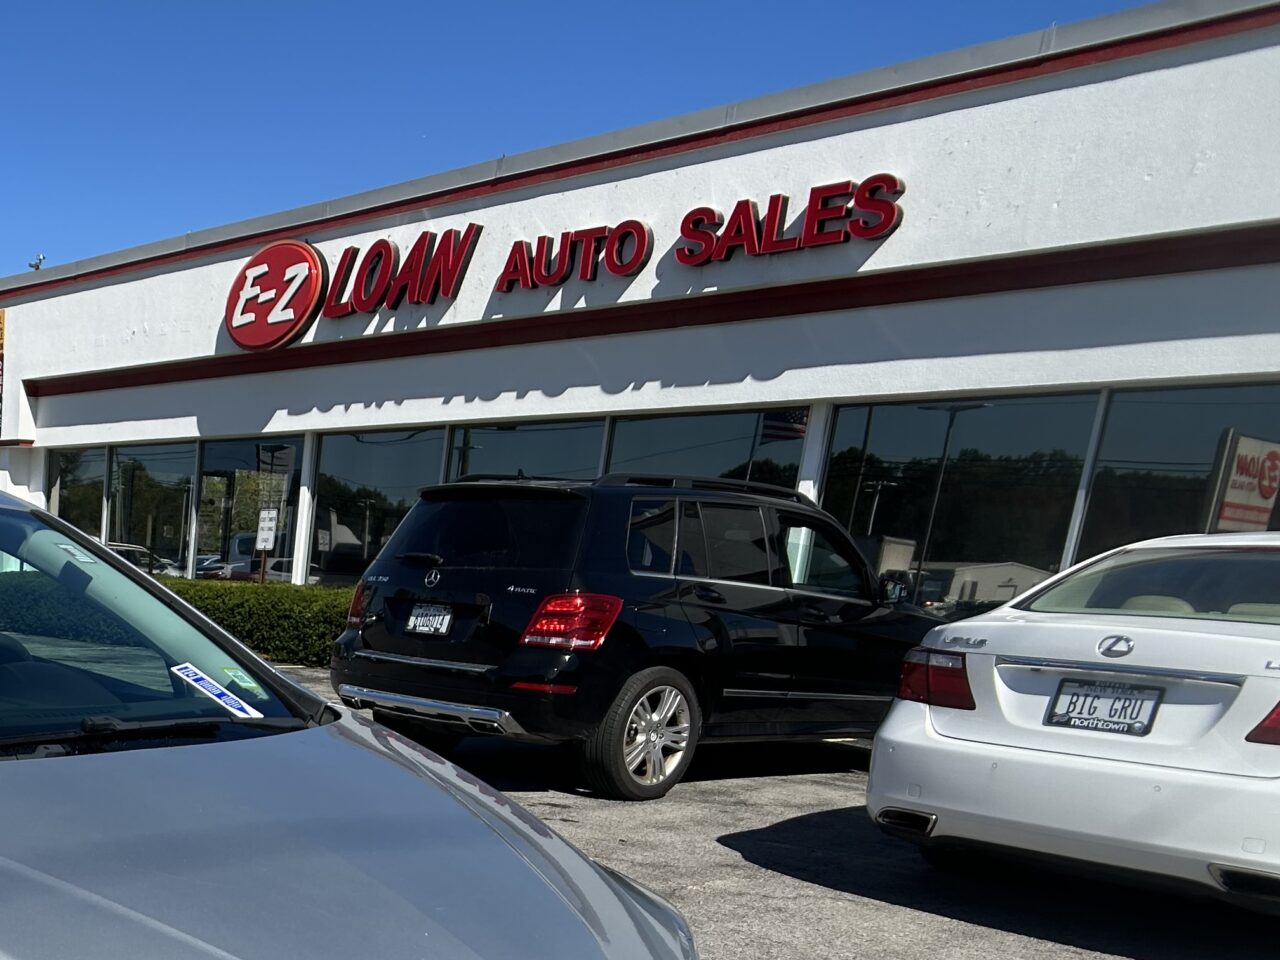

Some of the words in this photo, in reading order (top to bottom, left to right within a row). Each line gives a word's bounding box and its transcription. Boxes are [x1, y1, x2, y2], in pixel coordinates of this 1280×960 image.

[231, 262, 309, 328] E-Z
[322, 223, 484, 318] LOAN
[496, 219, 654, 293] AUTO
[675, 173, 906, 267] SALES
[1067, 692, 1100, 716] BIG
[1109, 697, 1144, 720] GRU
[1071, 717, 1128, 731] northtown
